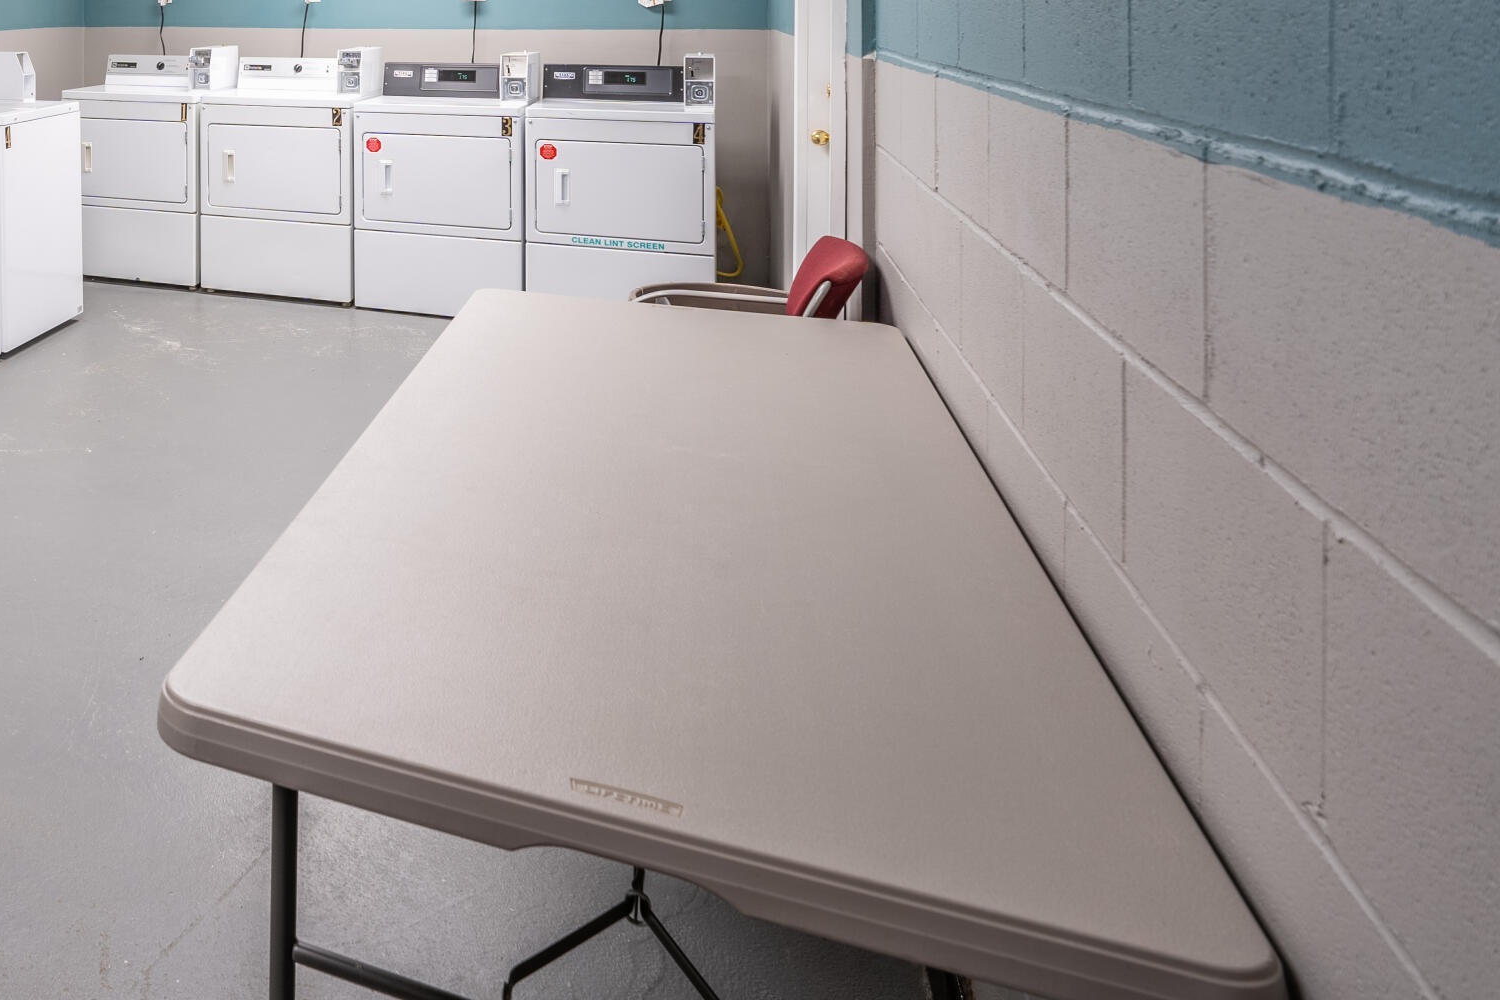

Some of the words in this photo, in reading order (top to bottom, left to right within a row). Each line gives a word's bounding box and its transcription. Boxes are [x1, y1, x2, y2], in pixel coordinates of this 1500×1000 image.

[332, 108, 342, 127] 2
[502, 116, 512, 136] 3
[693, 123, 705, 144] 4
[571, 236, 602, 246] CLEAN
[604, 239, 625, 247] LINT
[627, 240, 666, 250] SCREEN
